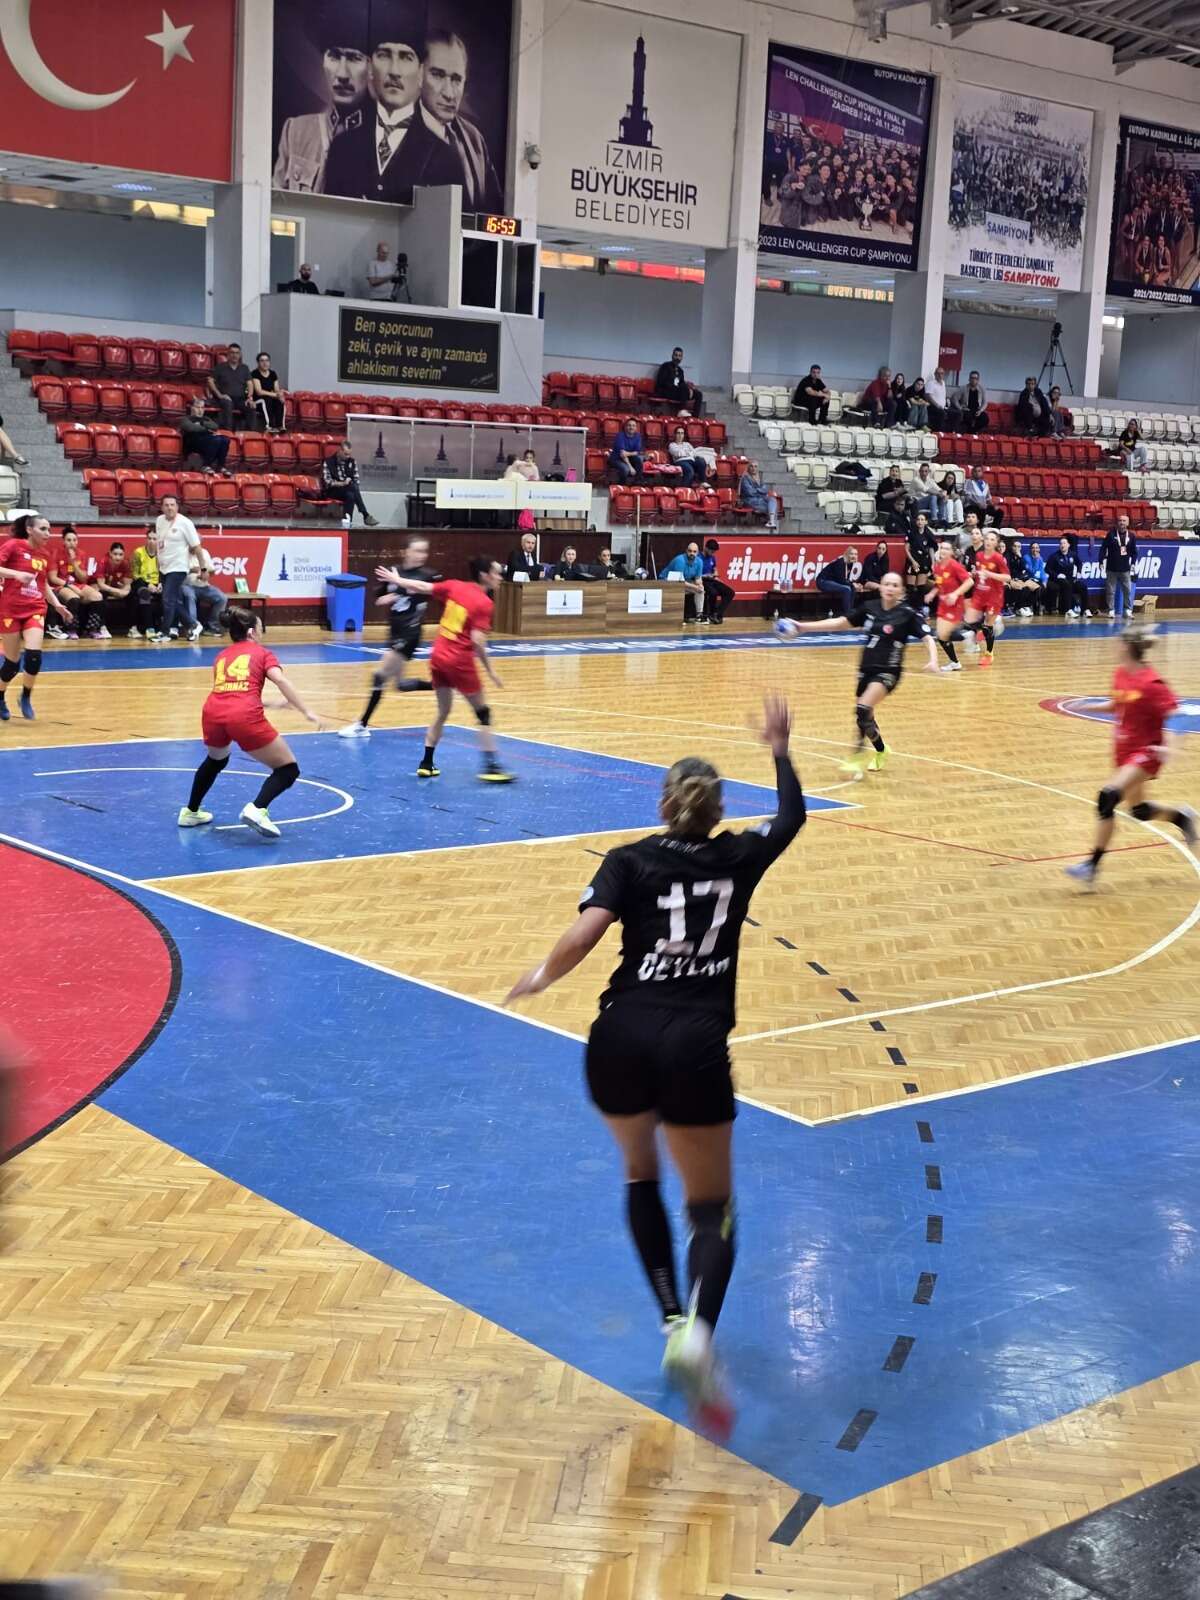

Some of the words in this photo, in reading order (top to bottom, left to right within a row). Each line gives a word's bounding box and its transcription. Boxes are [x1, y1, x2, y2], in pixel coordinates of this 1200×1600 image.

[785, 69, 799, 82] LEN
[799, 75, 843, 100] CHALLENGER
[843, 93, 858, 105] CUP
[857, 99, 882, 116] WOMEN
[883, 110, 901, 125] FINAL
[831, 100, 858, 119] ZAGREB
[605, 143, 663, 173] İZMİR
[570, 165, 698, 206] BÜYÜKŞEHİR
[486, 216, 516, 235] 16:53
[575, 197, 691, 230] BELEDİYESİ
[758, 235, 777, 247] 2023
[778, 237, 795, 249] LEN
[796, 239, 849, 257] CHALLENGER
[850, 246, 867, 257] CUP
[867, 248, 912, 264] ŞAMPİYONU
[969, 247, 993, 265] TÜRKİYE
[354, 316, 376, 332] Ben
[378, 322, 433, 339] sporcunun
[348, 338, 371, 356] zeki,
[374, 341, 402, 358] çevik
[406, 344, 418, 356] ve
[420, 346, 442, 362] aynı
[444, 348, 488, 363] zamanda
[347, 360, 399, 377] ahlaklısını
[215, 653, 251, 685] 14
[655, 878, 734, 956] 17
